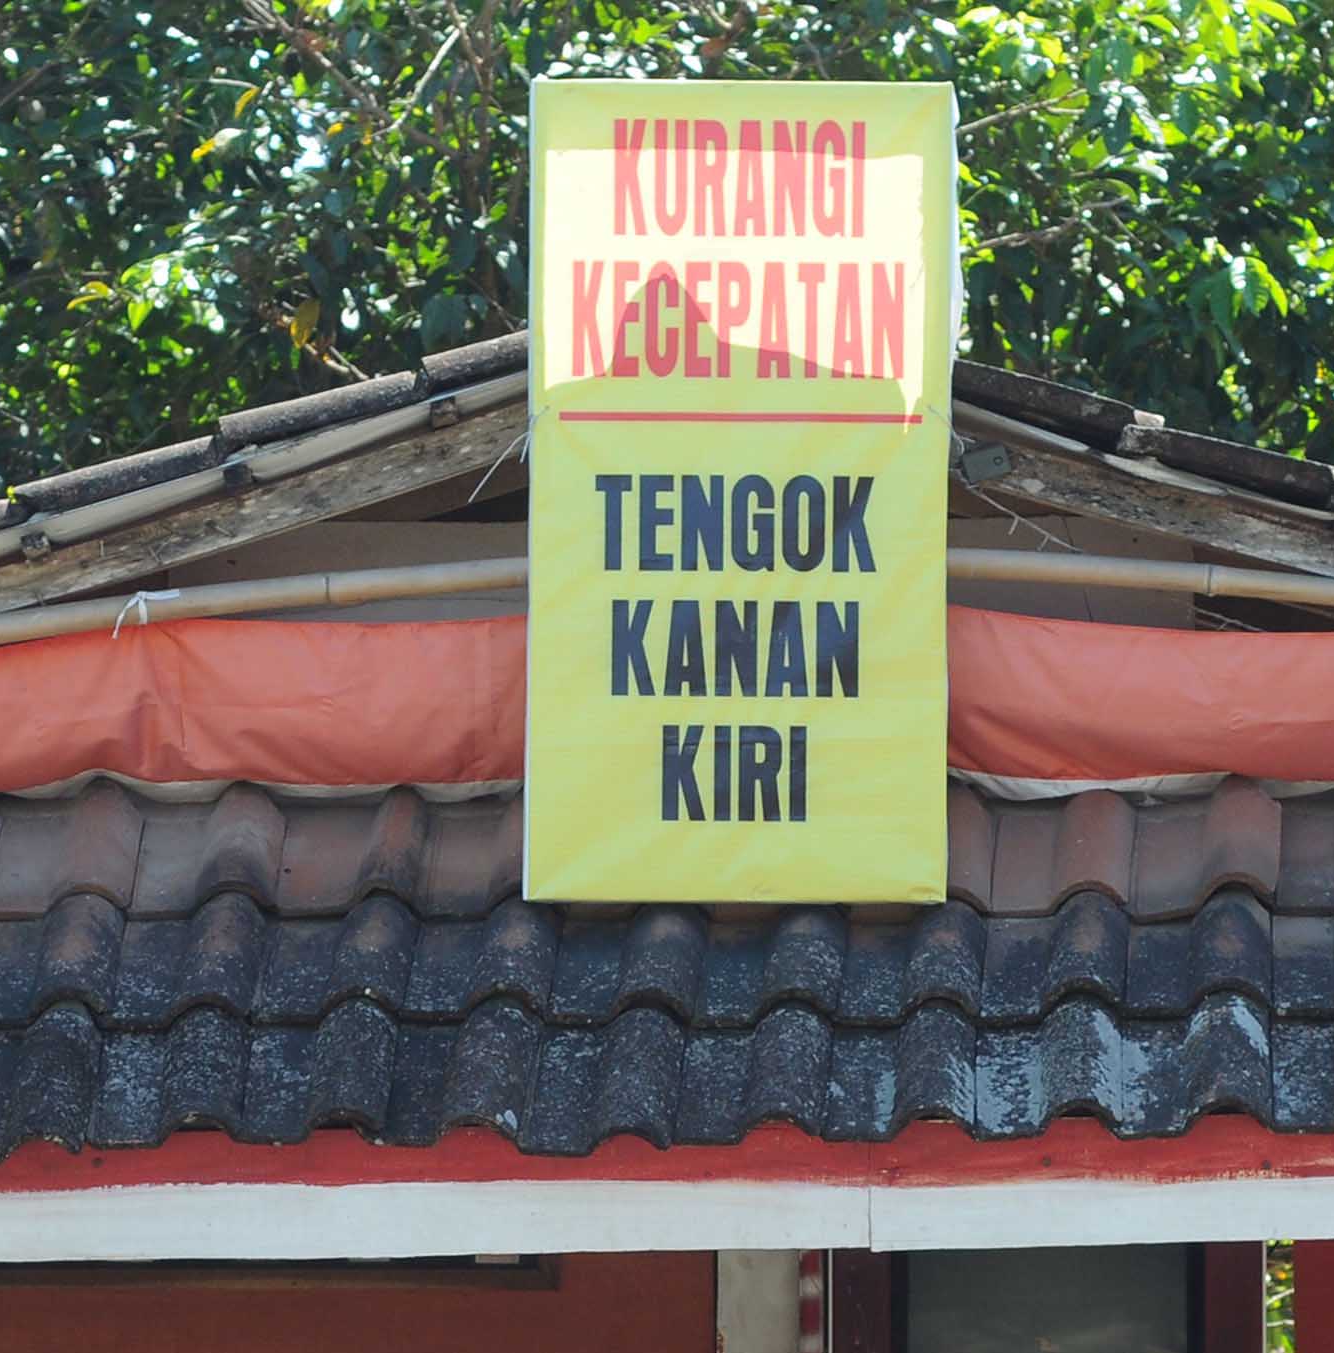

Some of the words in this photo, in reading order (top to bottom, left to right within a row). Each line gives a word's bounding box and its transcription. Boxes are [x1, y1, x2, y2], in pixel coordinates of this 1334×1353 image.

[612, 118, 867, 237] KURANGI
[571, 259, 905, 379] KECEPATAN
[595, 474, 876, 574] TENGOK
[610, 600, 859, 698] KANAN
[661, 724, 806, 822] KIRI
